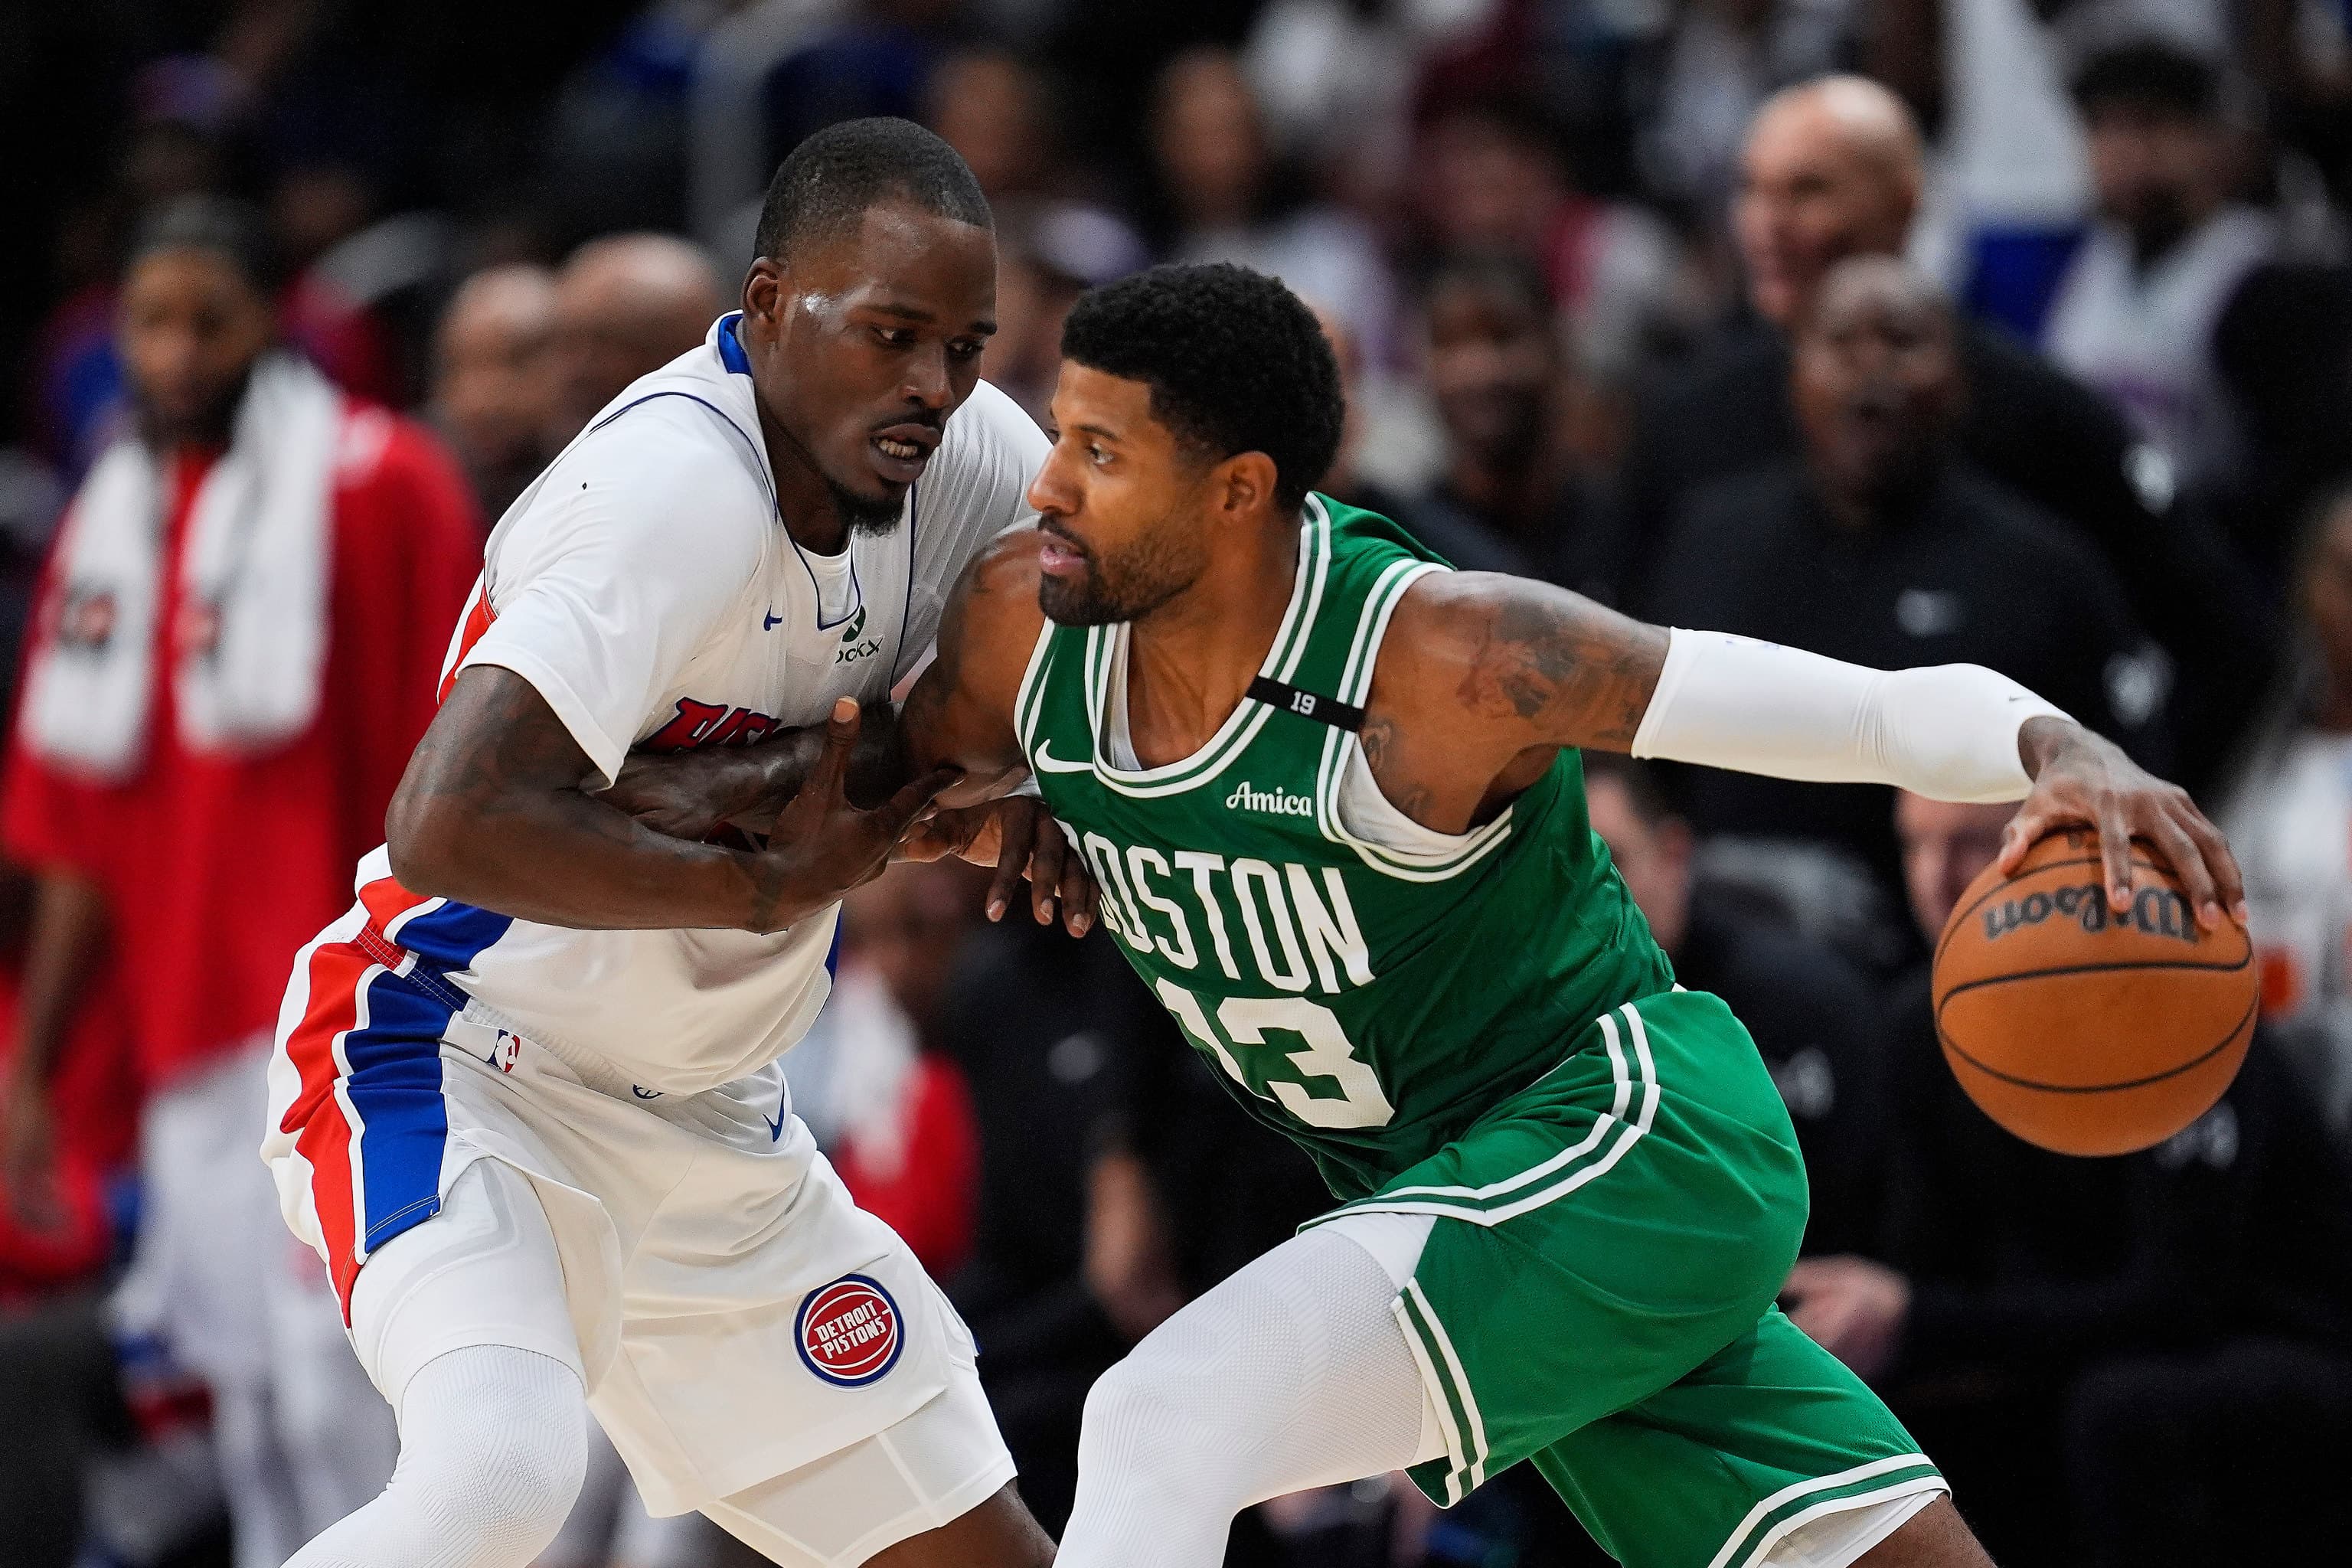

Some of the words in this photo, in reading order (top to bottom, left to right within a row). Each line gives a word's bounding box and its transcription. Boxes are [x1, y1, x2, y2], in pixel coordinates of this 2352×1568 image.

[1290, 691, 1317, 716] 19
[1225, 780, 1313, 818] Amica
[1155, 977, 1395, 1127] 13
[814, 1300, 877, 1342] DETROIT
[820, 1316, 887, 1359] PISTONS
